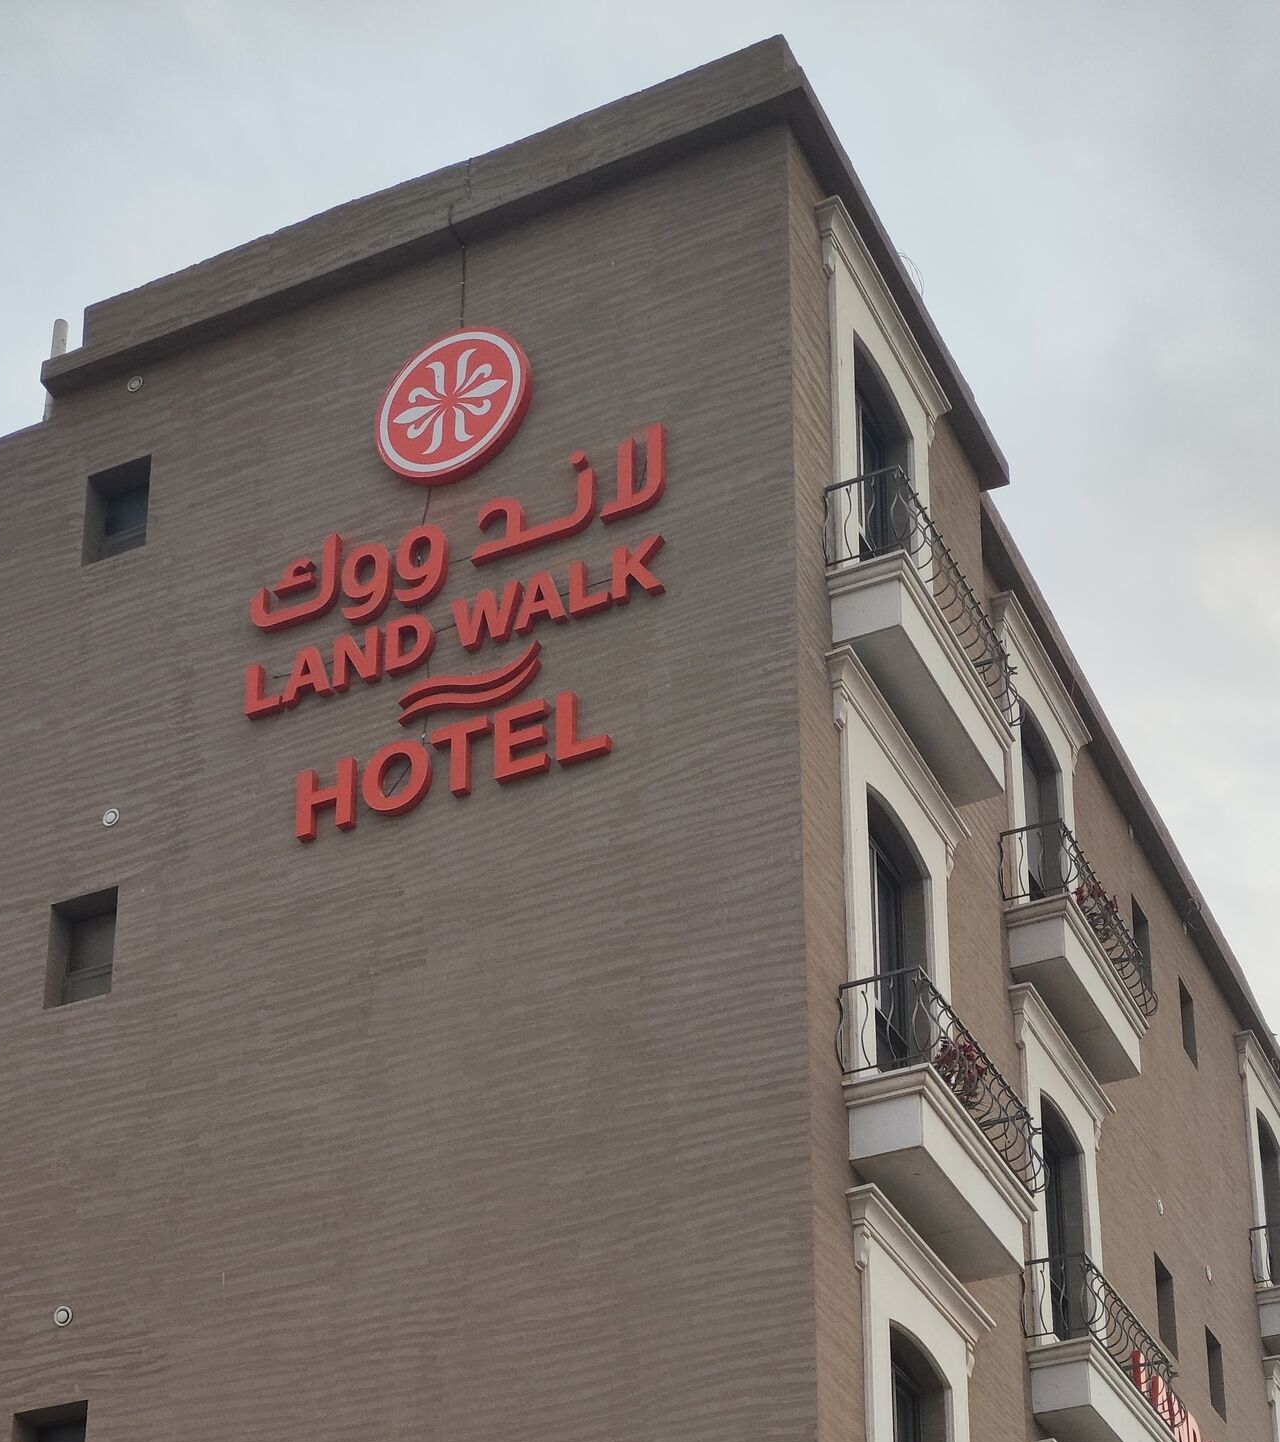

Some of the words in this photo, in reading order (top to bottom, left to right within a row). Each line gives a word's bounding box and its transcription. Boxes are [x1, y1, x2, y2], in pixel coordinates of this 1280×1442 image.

[471, 421, 668, 567] لاند
[243, 613, 437, 721] LAND
[451, 534, 666, 653] WALK
[249, 525, 448, 635] ووك
[295, 690, 614, 842] HOTEL
